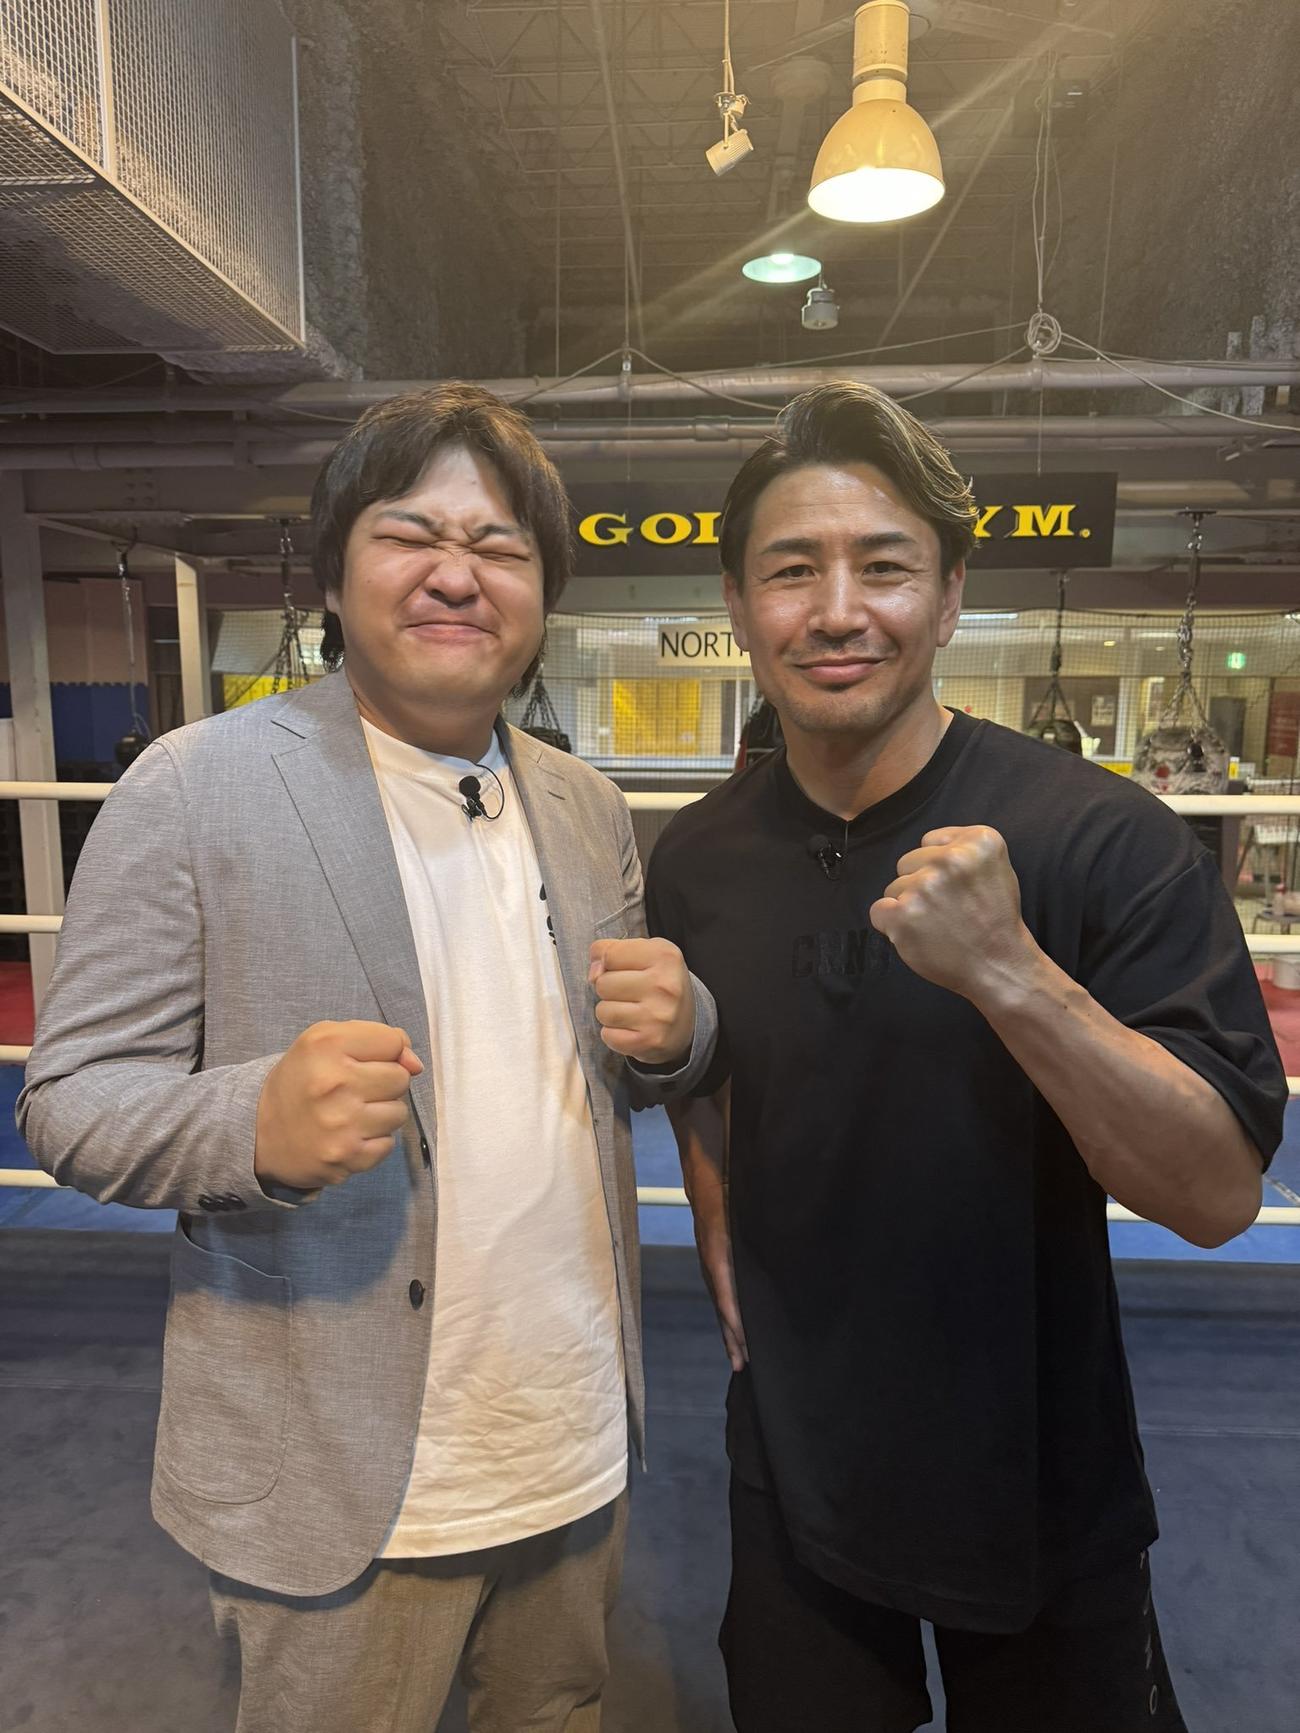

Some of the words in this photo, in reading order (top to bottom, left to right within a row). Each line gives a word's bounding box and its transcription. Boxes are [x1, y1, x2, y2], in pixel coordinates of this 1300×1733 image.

[579, 511, 721, 545] GOL
[971, 504, 1091, 538] YM.
[661, 631, 743, 658] NORT
